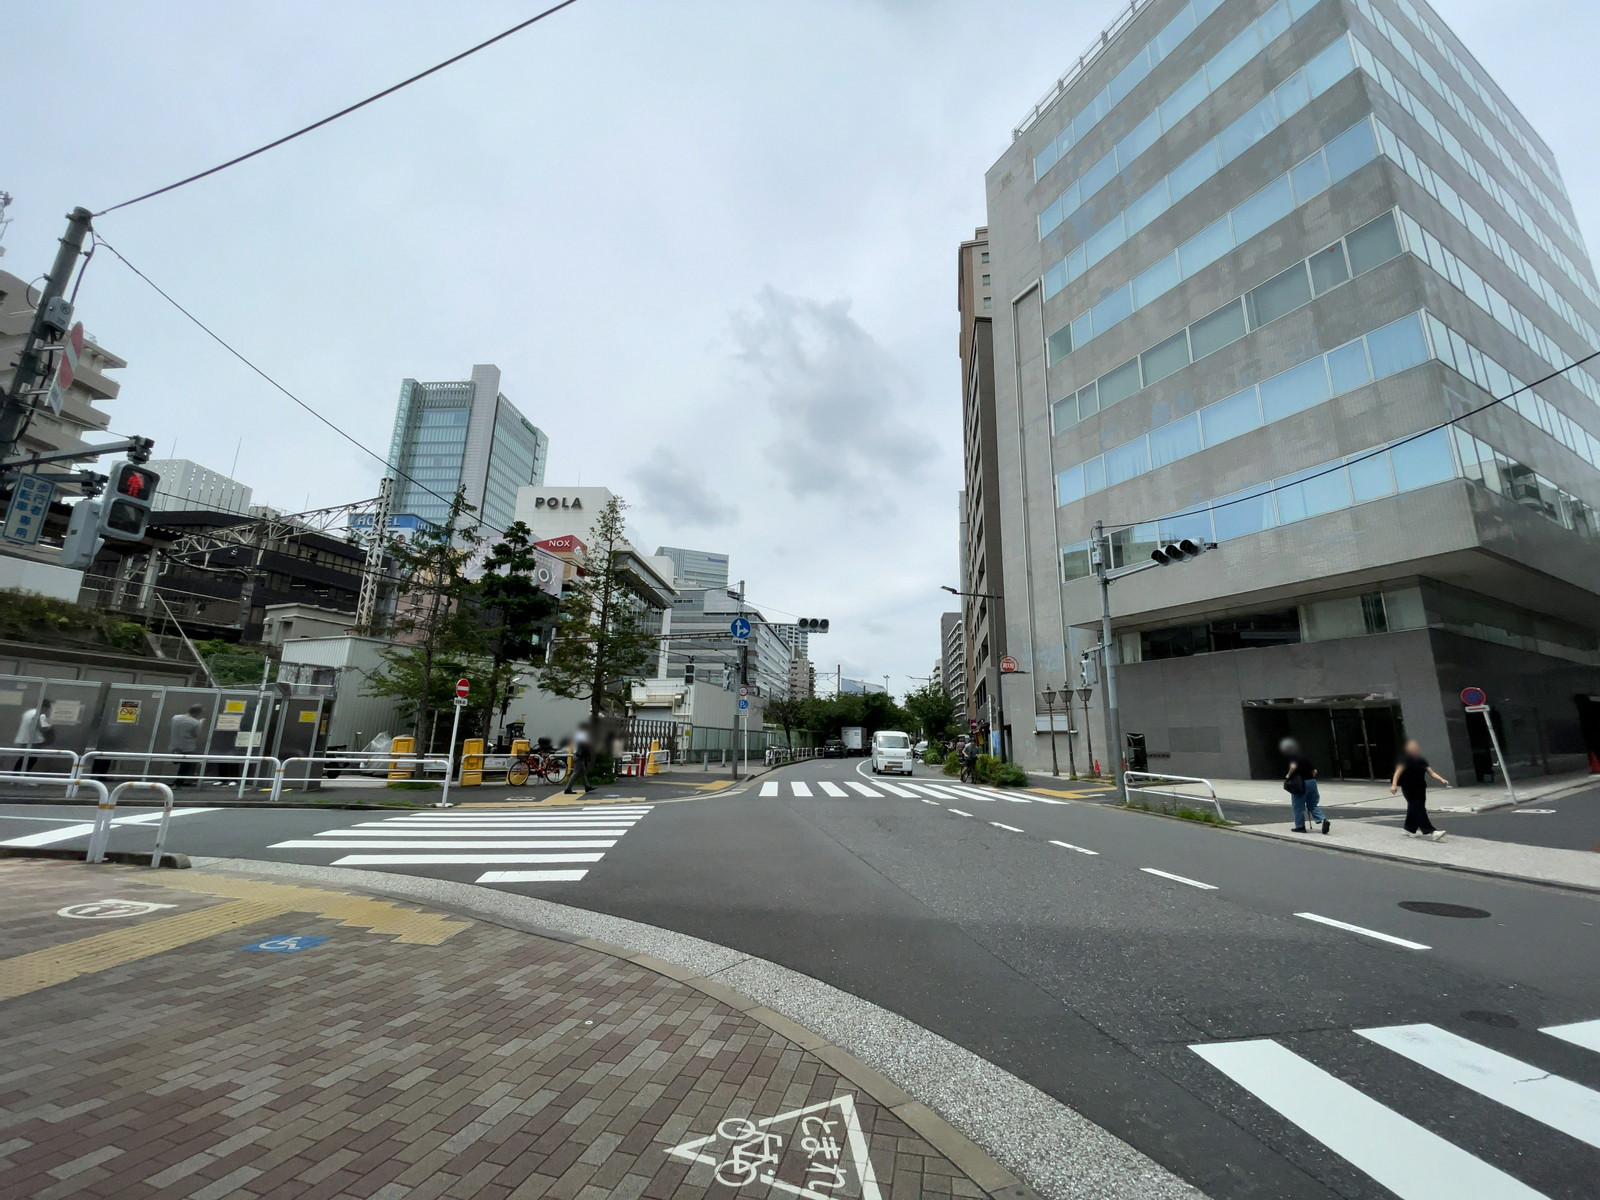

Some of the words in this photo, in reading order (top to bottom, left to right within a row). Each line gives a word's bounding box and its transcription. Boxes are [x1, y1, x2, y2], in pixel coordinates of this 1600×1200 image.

[535, 496, 583, 510] POLA
[801, 1116, 847, 1190] とまれ
